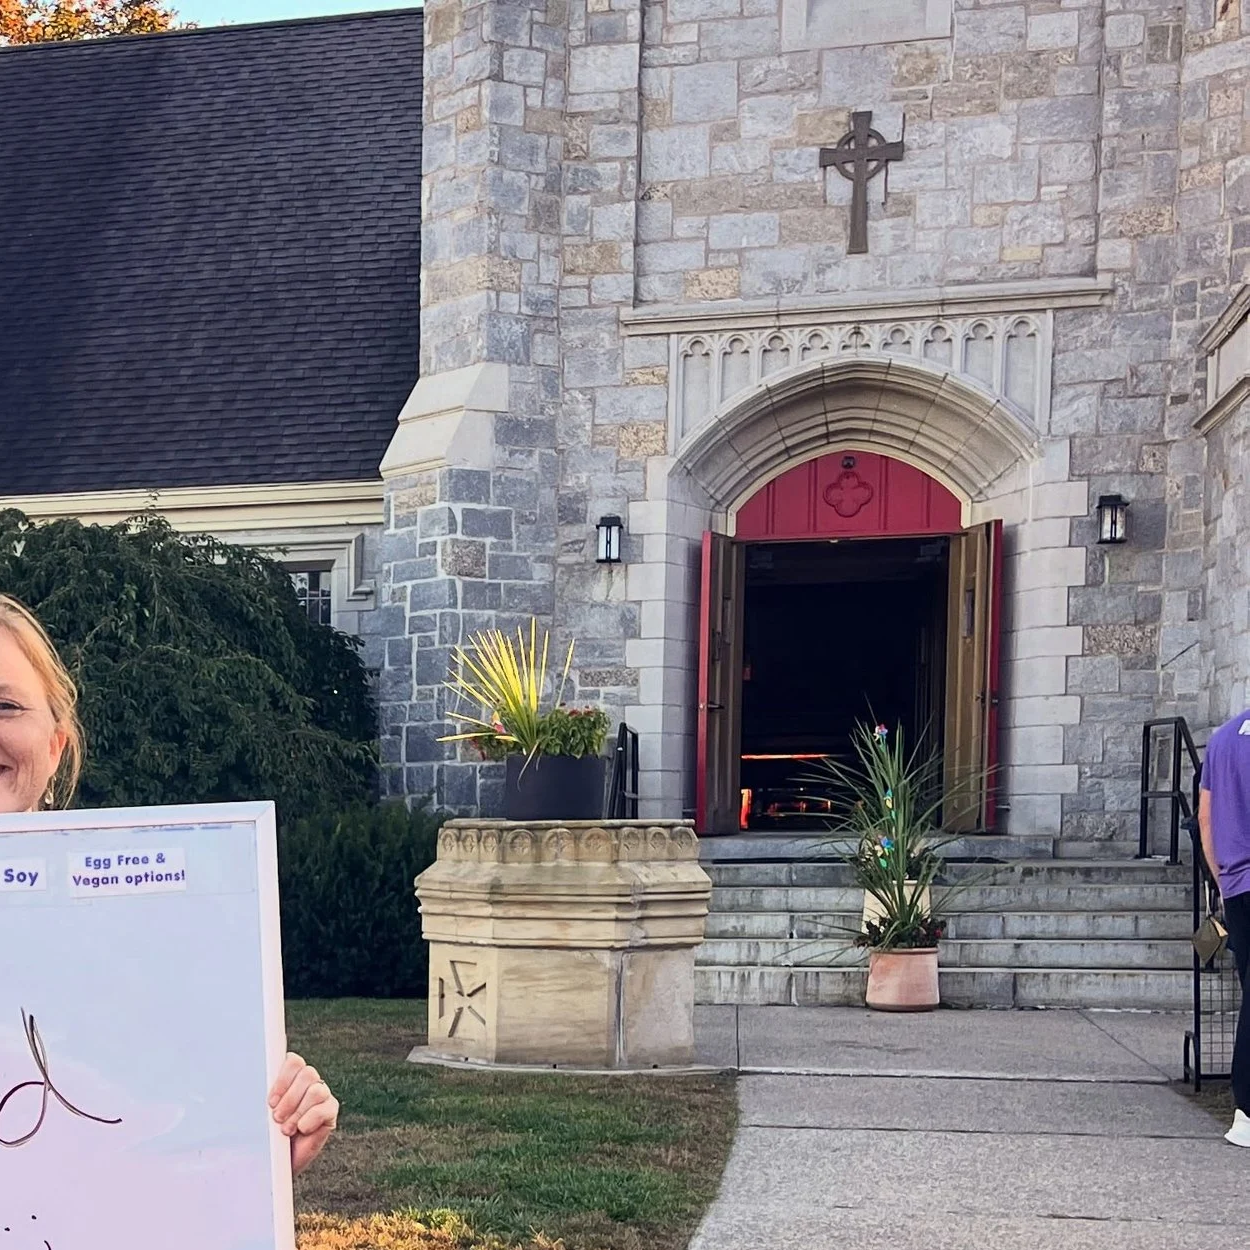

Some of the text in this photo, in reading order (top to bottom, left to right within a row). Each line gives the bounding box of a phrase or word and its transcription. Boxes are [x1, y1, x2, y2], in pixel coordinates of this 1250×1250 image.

[85, 852, 166, 870] Egg Free &
[3, 868, 39, 887] Soy
[72, 869, 185, 888] Vegan options!
